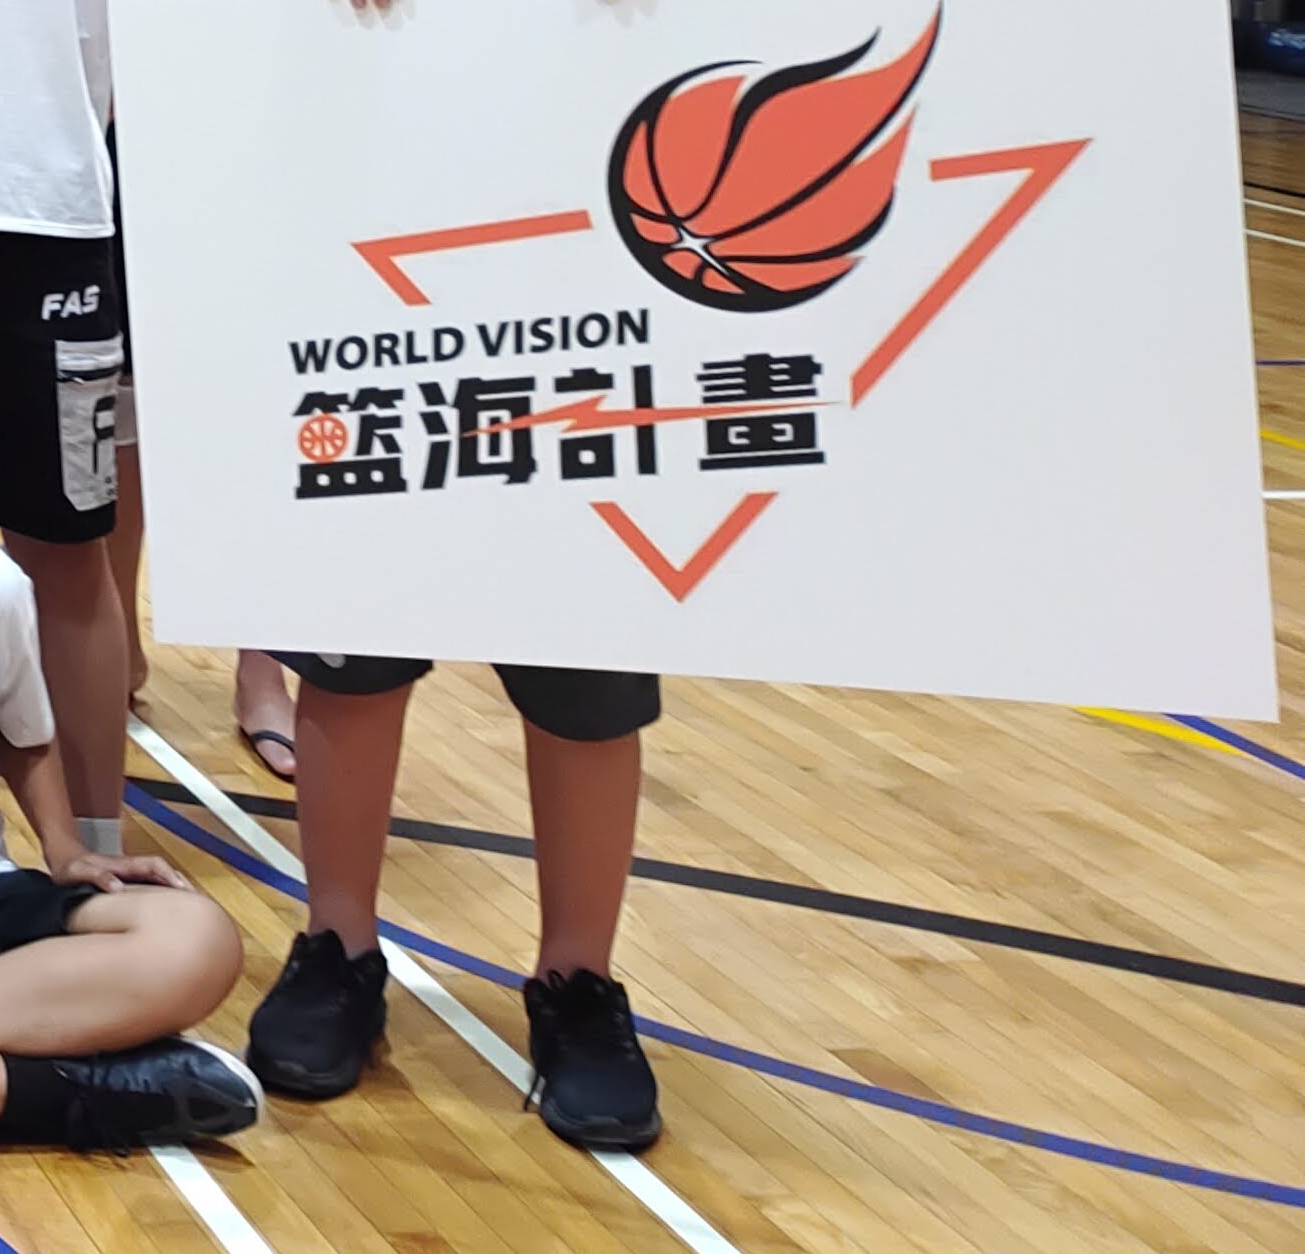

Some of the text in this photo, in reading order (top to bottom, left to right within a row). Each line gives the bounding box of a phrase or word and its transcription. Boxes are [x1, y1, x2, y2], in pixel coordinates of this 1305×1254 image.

[289, 309, 650, 374] WORLD VISION
[293, 353, 827, 499] 籃海計畫
